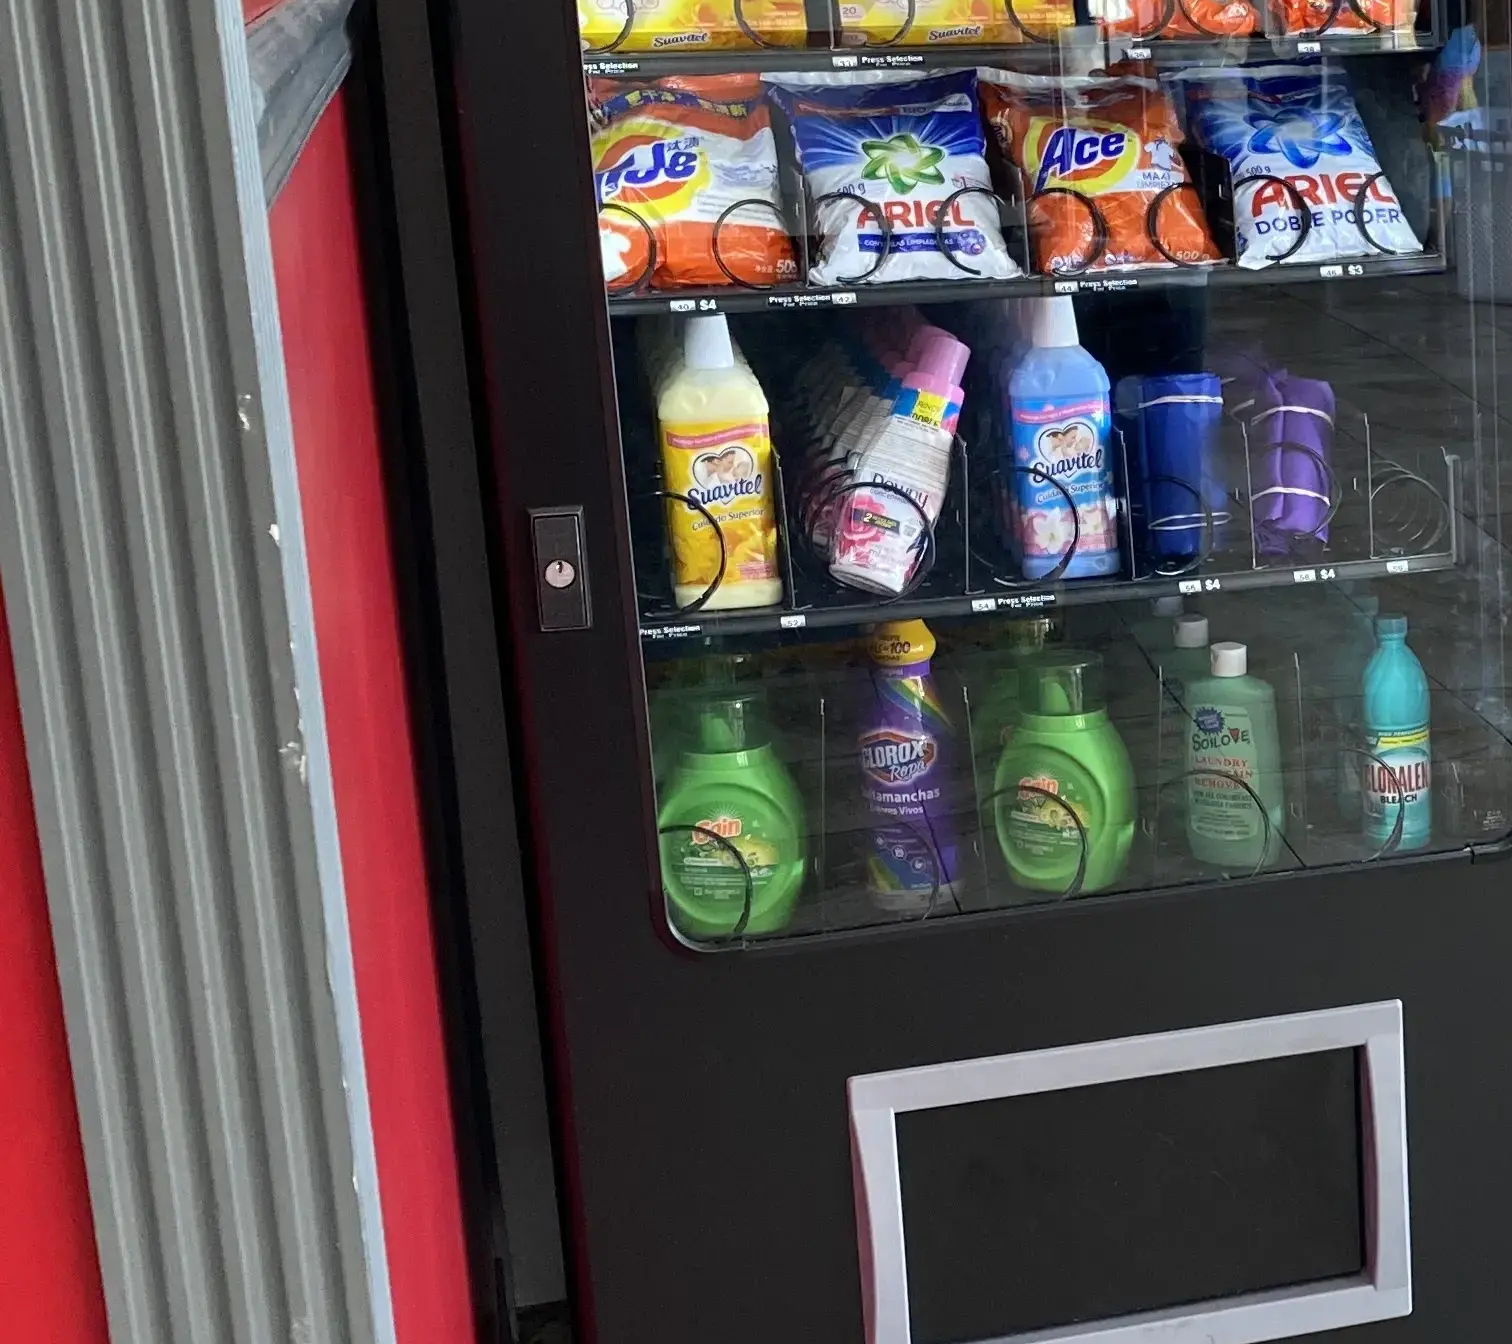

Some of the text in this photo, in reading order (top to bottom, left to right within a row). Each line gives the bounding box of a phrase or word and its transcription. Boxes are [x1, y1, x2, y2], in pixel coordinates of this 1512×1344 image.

[842, 7, 857, 15] 20
[928, 25, 981, 41] Suavitel
[861, 56, 885, 65] Press
[886, 55, 924, 65] Selection
[1034, 128, 1127, 195] Ace
[1251, 172, 1397, 218] ARIEL
[856, 199, 975, 230] ARIEL
[1347, 265, 1364, 276] $3
[1060, 285, 1074, 293] 44
[769, 293, 831, 305] Press Selection
[1032, 448, 1103, 484] Suavitel
[687, 473, 763, 510] Suavitel
[872, 471, 929, 508] Downy
[727, 508, 765, 523] Superior
[863, 512, 873, 522] 2
[978, 602, 990, 610] 54
[997, 597, 1020, 606] Press
[639, 627, 662, 637] Press
[889, 641, 911, 654] 100
[862, 739, 928, 769] CLOROX
[1195, 755, 1249, 768] LAUNDRY
[889, 760, 927, 782] Ropa
[899, 805, 924, 816] Vivos
